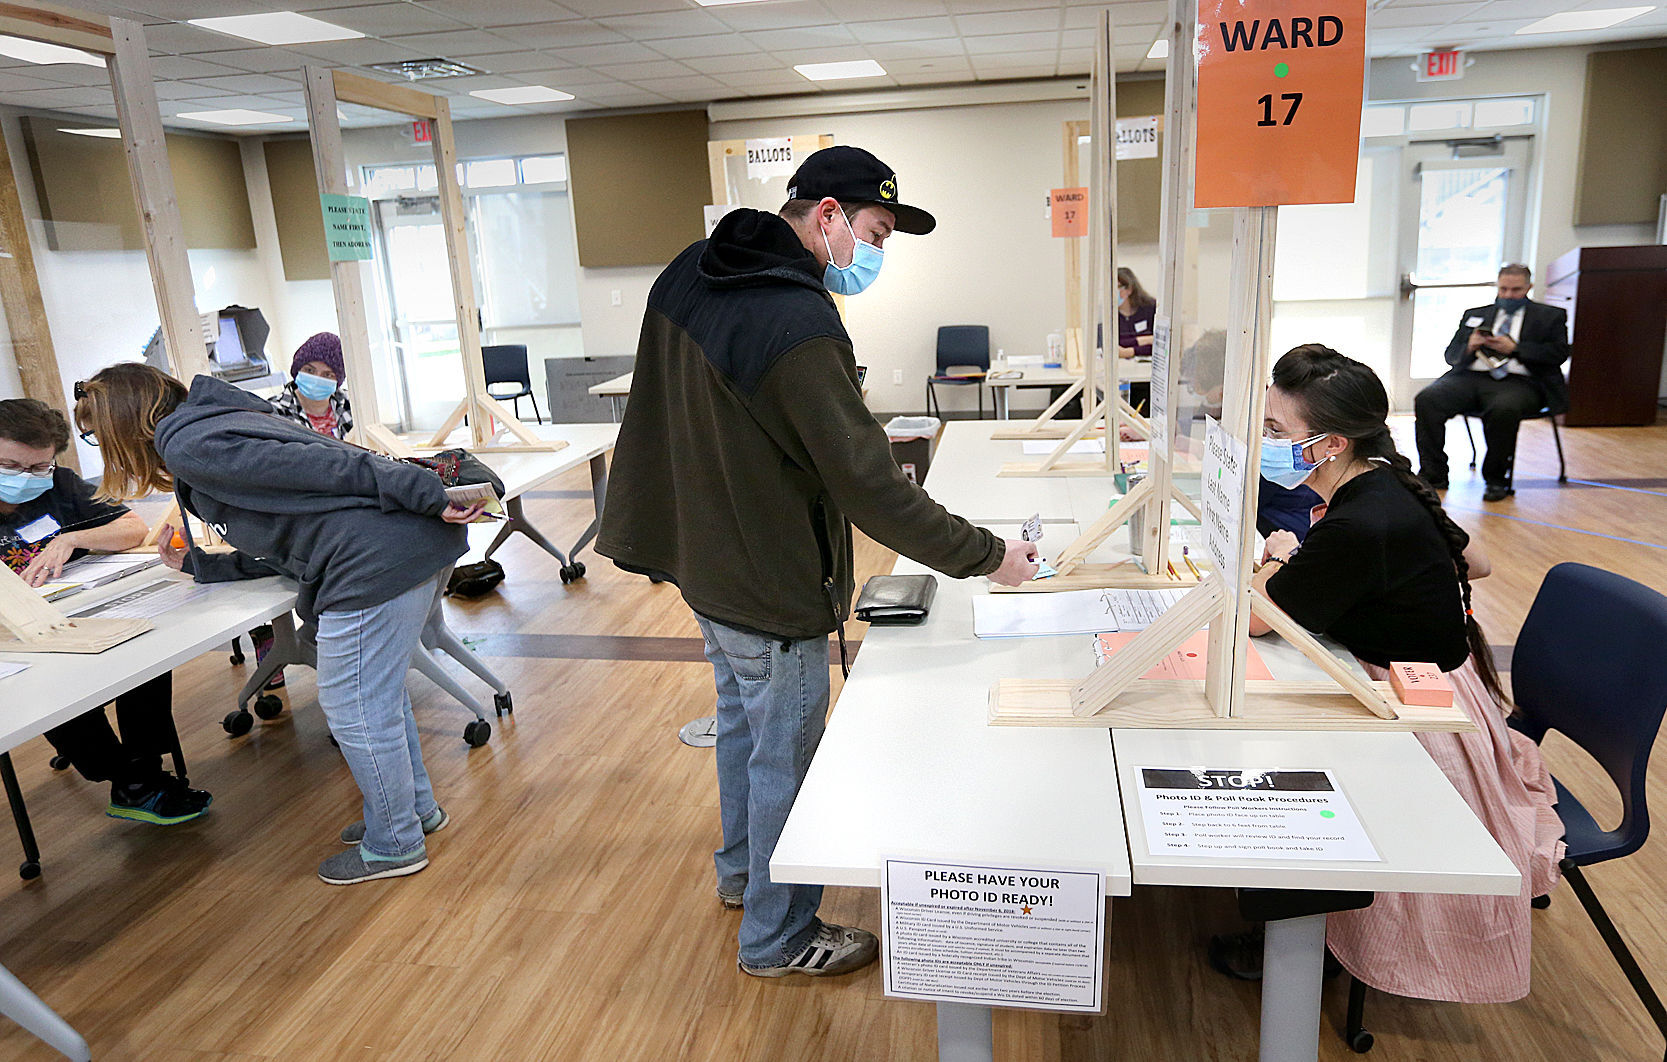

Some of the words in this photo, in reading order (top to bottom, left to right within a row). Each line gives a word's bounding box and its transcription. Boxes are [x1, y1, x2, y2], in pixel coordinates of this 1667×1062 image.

[1220, 16, 1344, 52] WARD
[1428, 51, 1458, 76] EXIT
[1258, 92, 1303, 126] 17
[413, 121, 432, 142] EXI
[748, 147, 792, 163] BALLOTS
[1055, 194, 1084, 202] WARD
[328, 206, 347, 214] PLEASE
[1065, 211, 1076, 219] 17
[1209, 435, 1222, 461] Please
[1207, 473, 1217, 494] Last
[1217, 482, 1231, 513] Name
[1206, 501, 1216, 525] First
[1215, 510, 1229, 544] Name
[1209, 533, 1225, 569] Address
[1199, 774, 1274, 788] STOP!
[925, 871, 973, 884] PLEASE
[978, 874, 1015, 887] HAVE
[1020, 877, 1060, 889] YOUR
[931, 888, 979, 902] PHOTO
[984, 892, 997, 903] ID
[1002, 893, 1053, 907] READY!
